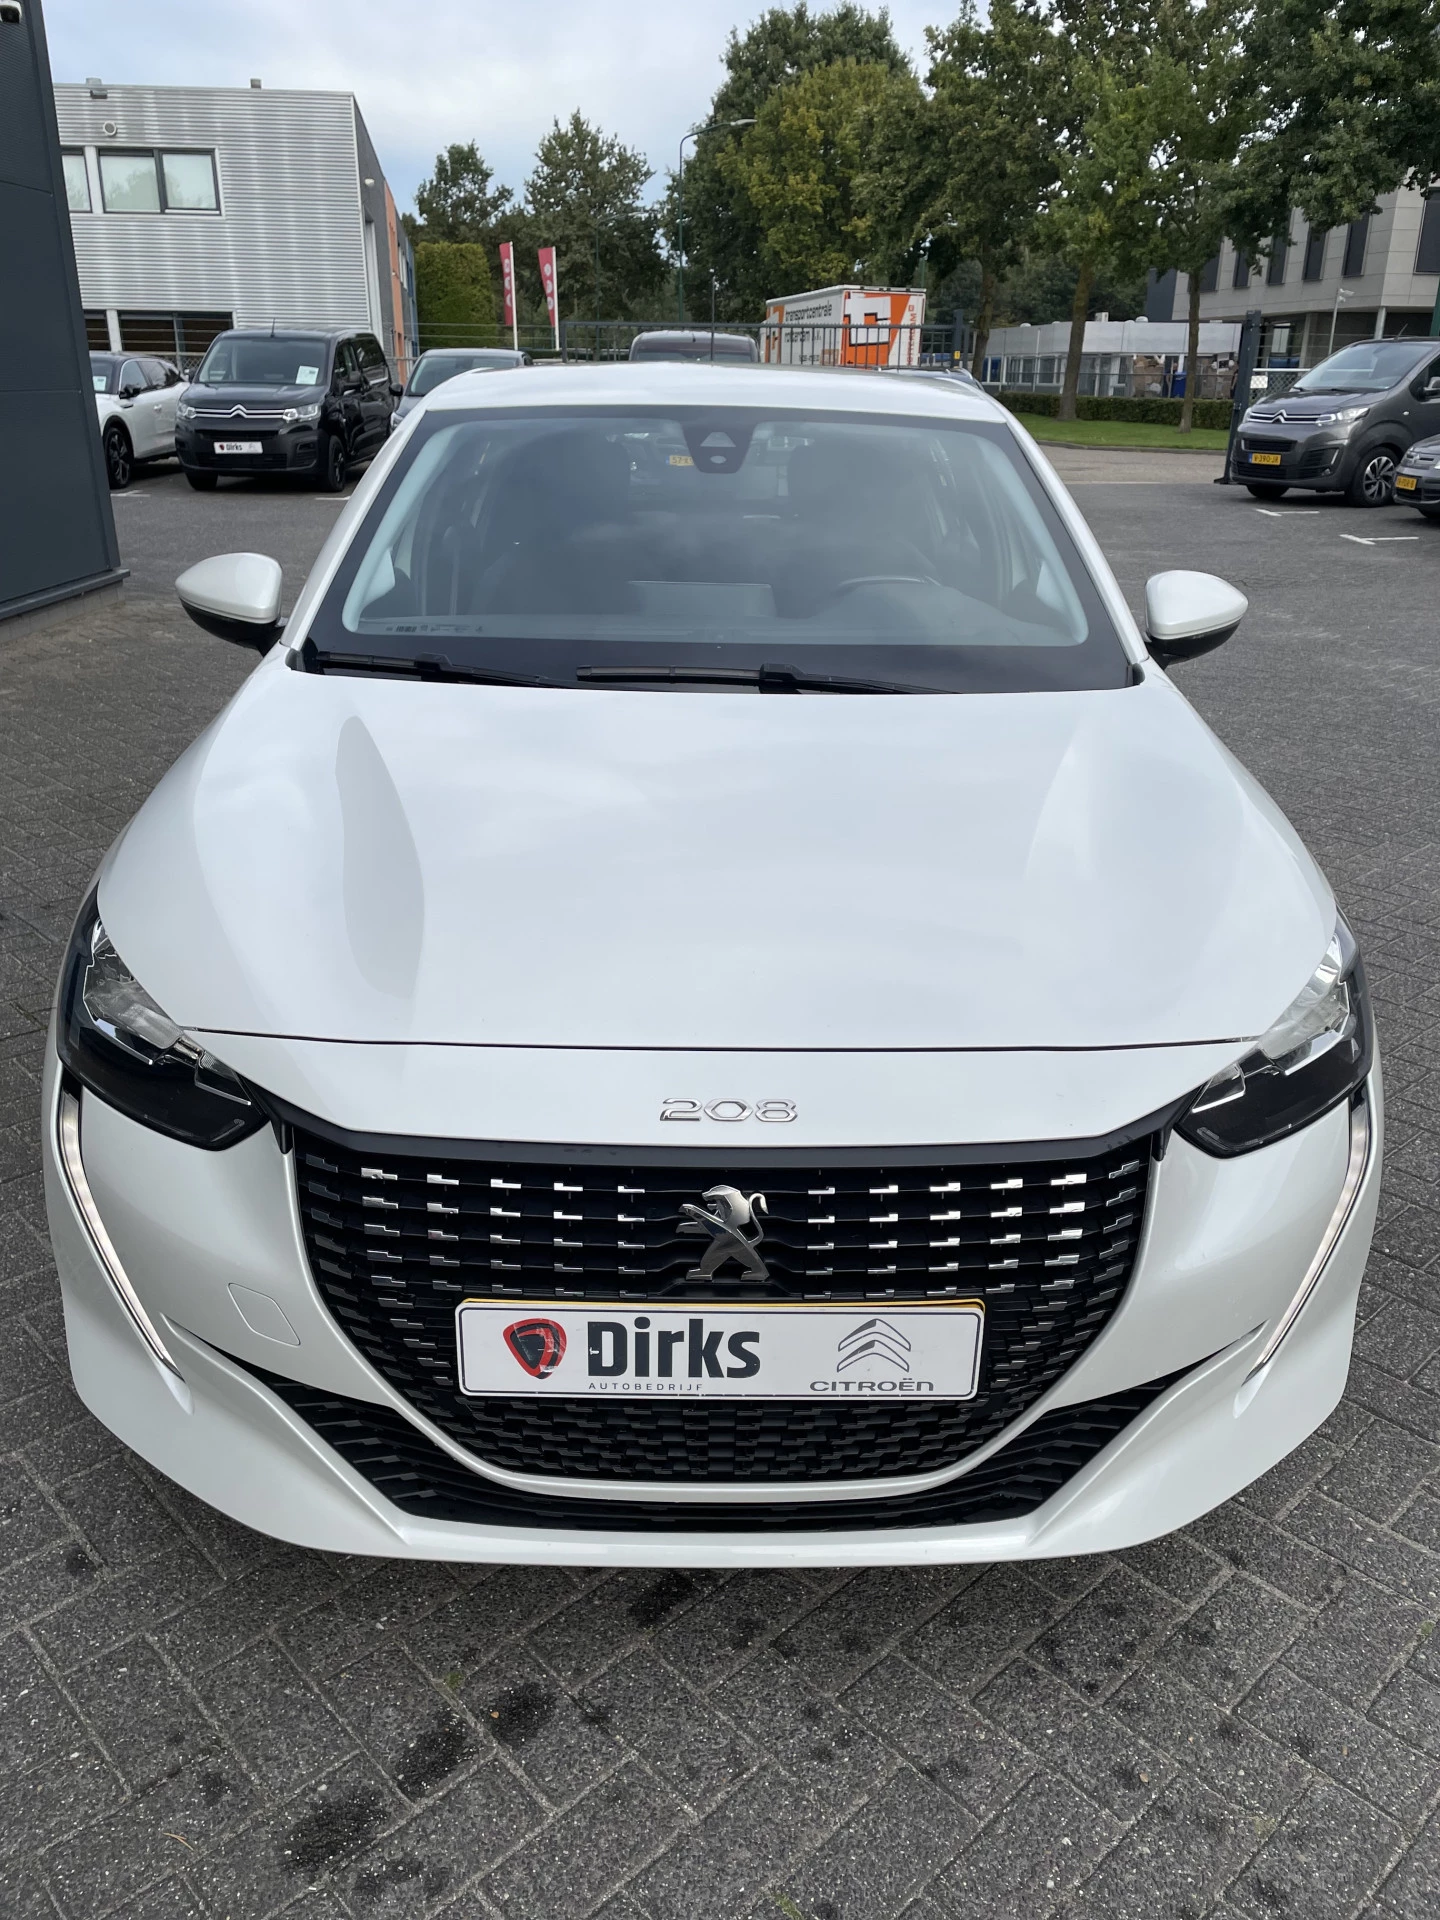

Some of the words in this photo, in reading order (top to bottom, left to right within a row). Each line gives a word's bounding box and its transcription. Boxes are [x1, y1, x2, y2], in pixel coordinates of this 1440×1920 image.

[785, 300, 833, 322] transportcentrale
[660, 1097, 798, 1123] 208
[587, 1317, 761, 1379] Dirks
[588, 1382, 704, 1392] AUTOBEDRIJF
